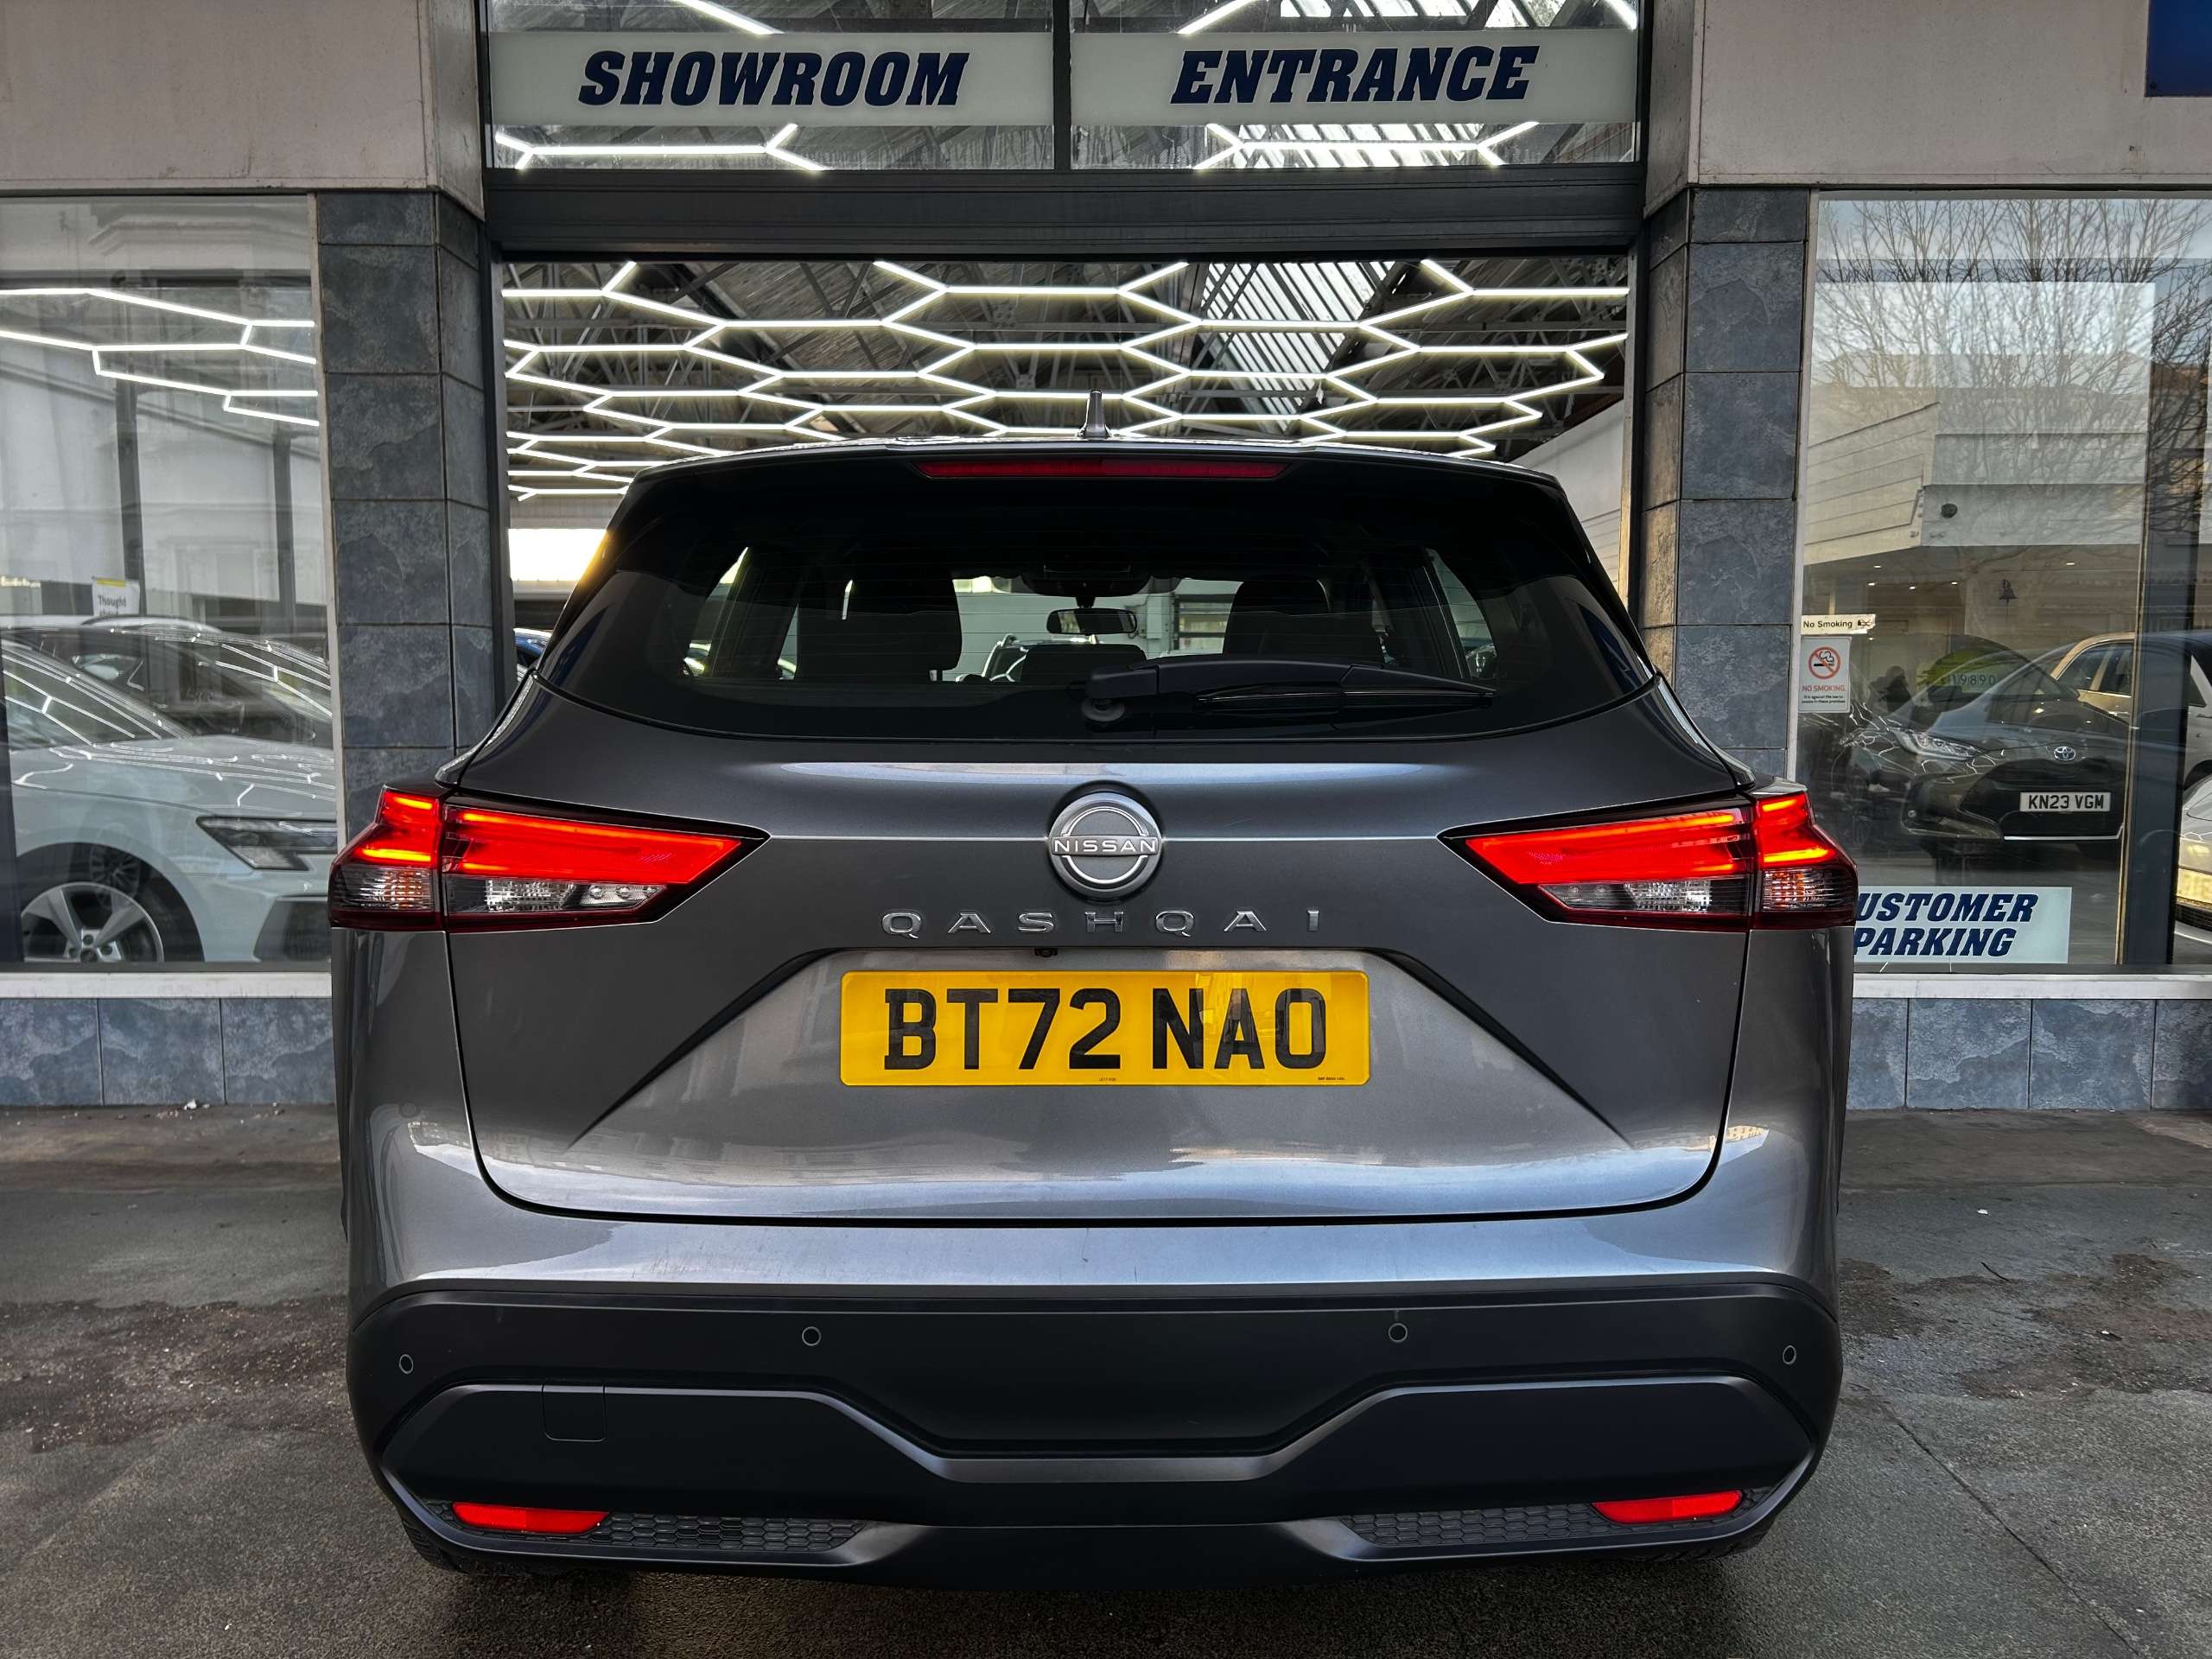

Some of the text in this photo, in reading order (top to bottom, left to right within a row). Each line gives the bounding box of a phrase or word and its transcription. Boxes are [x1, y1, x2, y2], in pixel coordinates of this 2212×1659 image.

[577, 45, 1541, 107] SHOWROOM ENTRANCE
[1817, 620, 1853, 629] Smoking
[2028, 794, 2105, 810] KN23 VGM
[1053, 837, 1158, 853] NISSAN
[1857, 892, 2039, 923] USTOMER
[880, 908, 1320, 940] QASHQAI
[1854, 926, 2018, 957] PARKING
[883, 987, 1327, 1071] BT72 NAO
